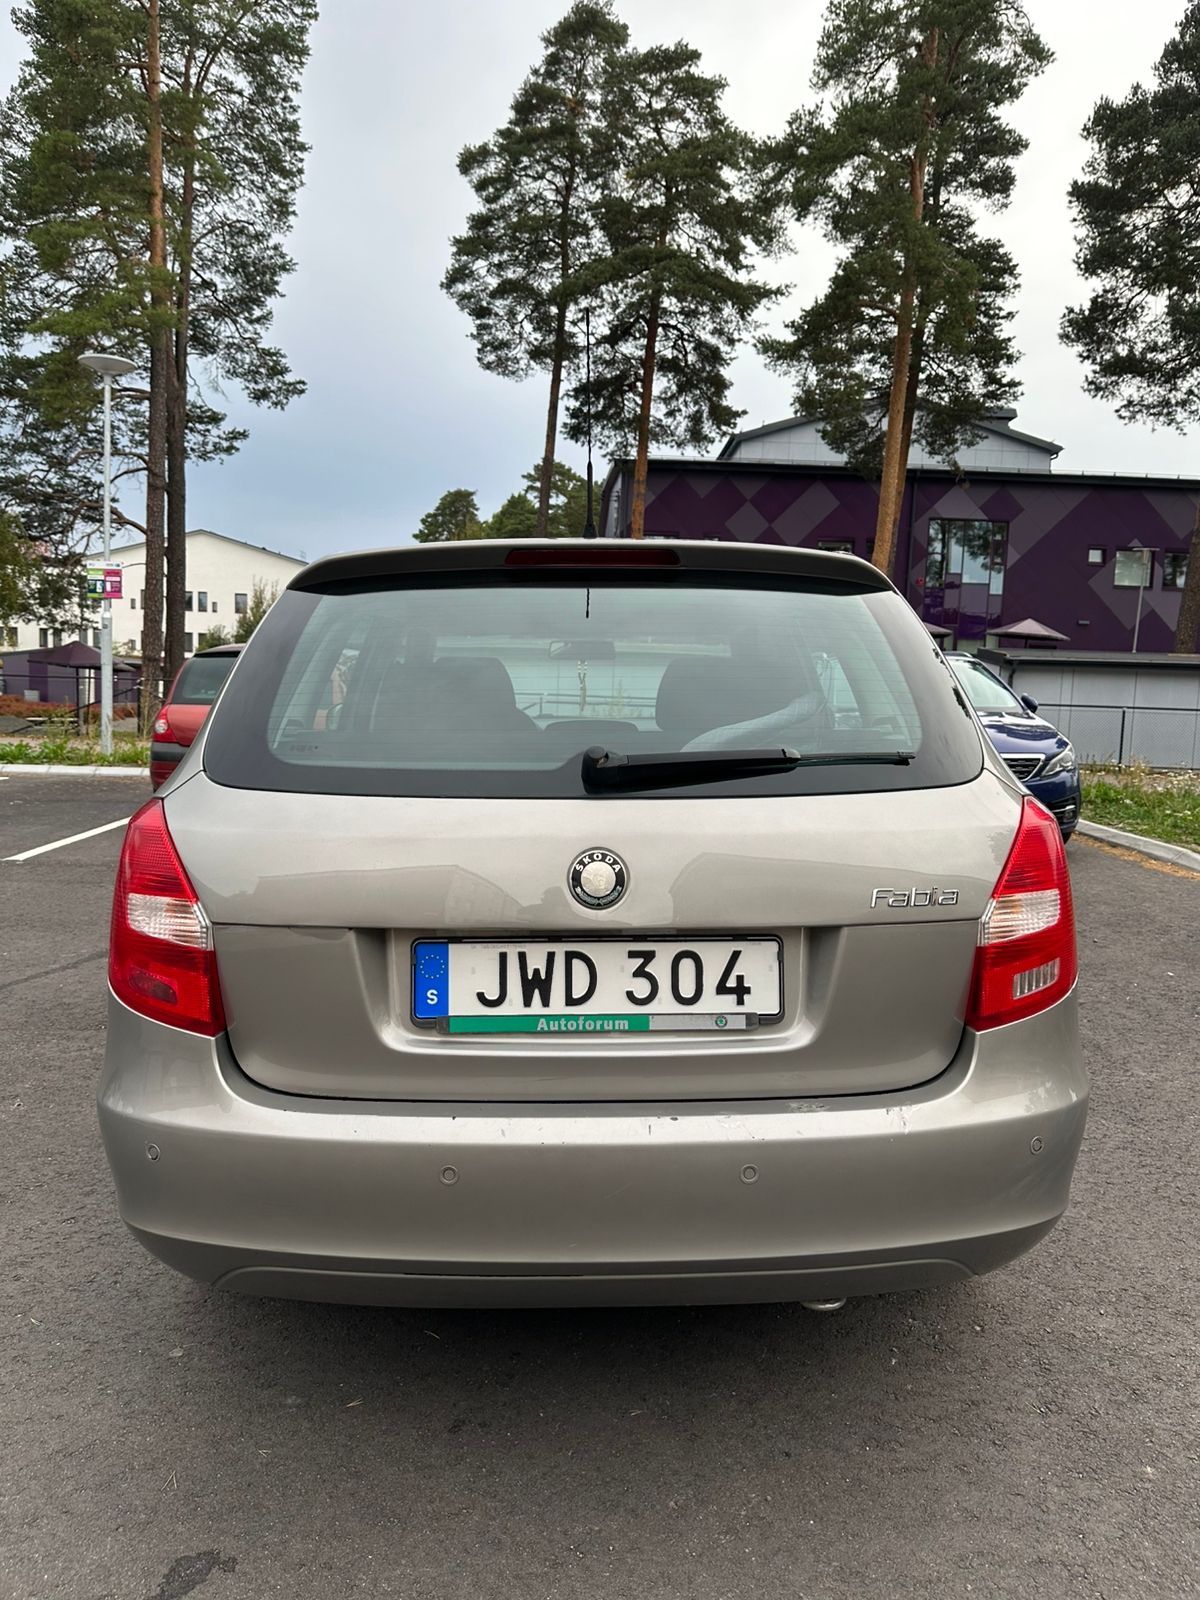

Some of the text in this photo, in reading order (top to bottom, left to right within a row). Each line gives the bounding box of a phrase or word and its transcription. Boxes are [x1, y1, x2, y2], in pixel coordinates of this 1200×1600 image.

[870, 886, 959, 908] Fabia
[476, 949, 751, 1007] JWD 304
[426, 989, 438, 1004] S
[537, 1016, 629, 1031] Autoforum
